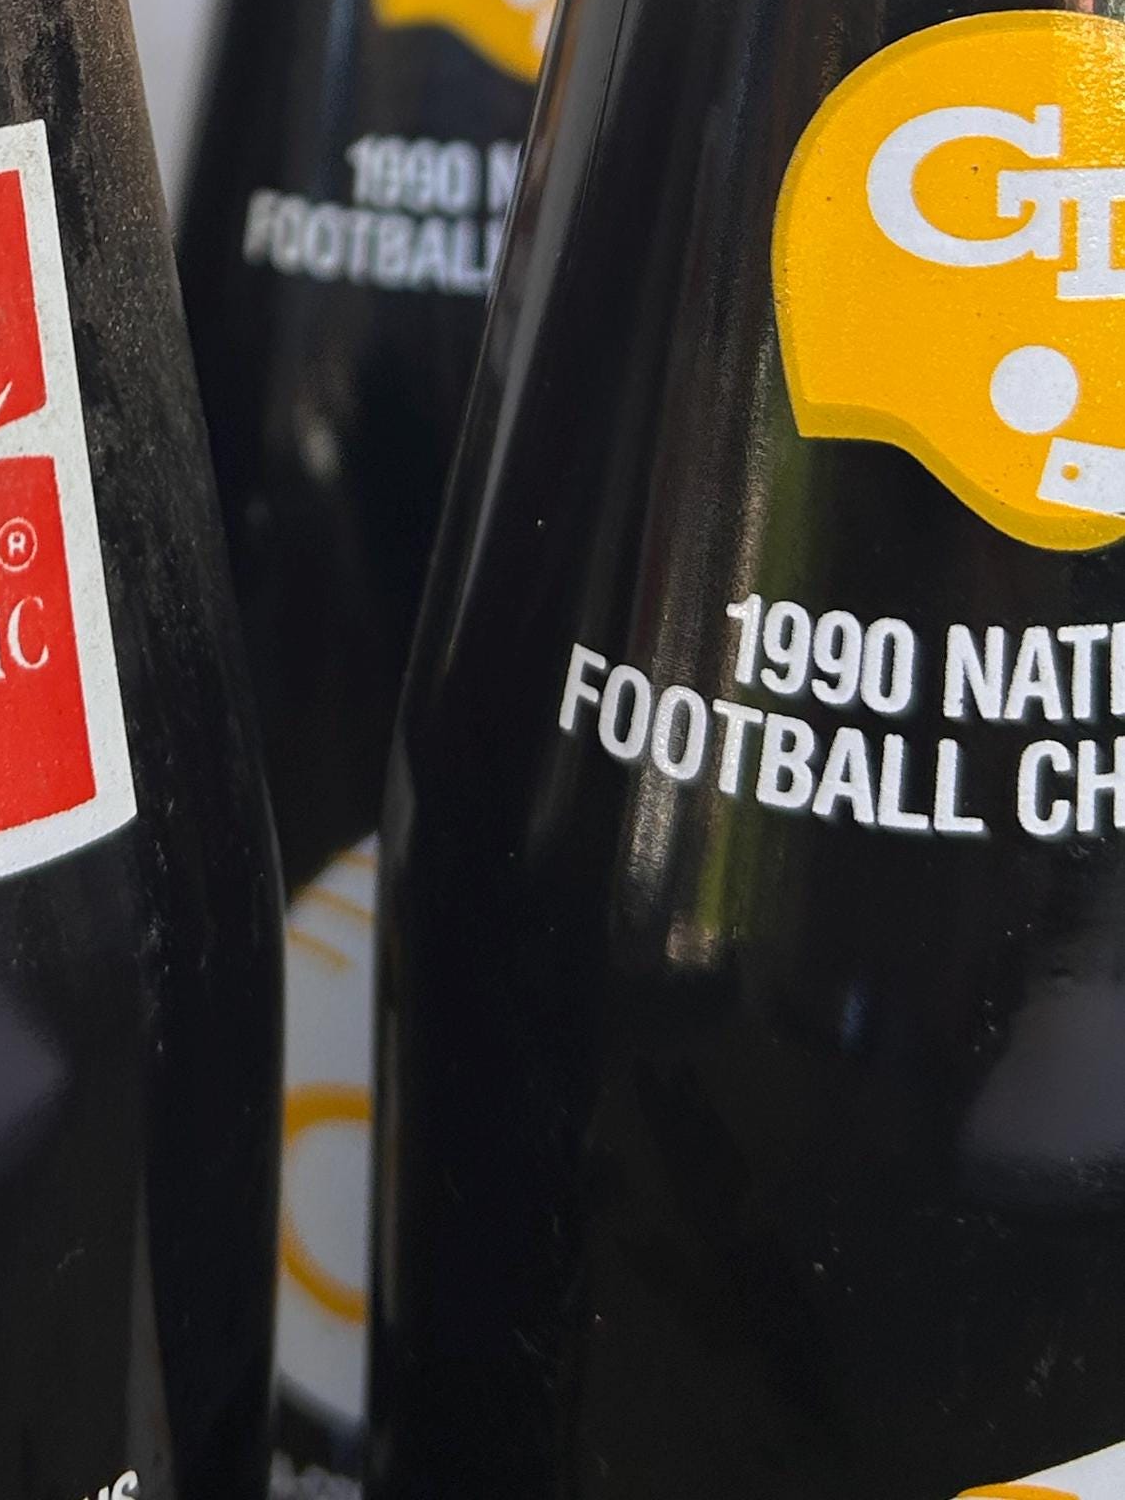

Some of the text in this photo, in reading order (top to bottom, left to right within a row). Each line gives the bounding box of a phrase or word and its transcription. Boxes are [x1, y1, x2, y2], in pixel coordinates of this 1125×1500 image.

[345, 135, 477, 214] 1990
[725, 592, 915, 715] 1990
[557, 641, 1125, 836] FOOTBALL CH
